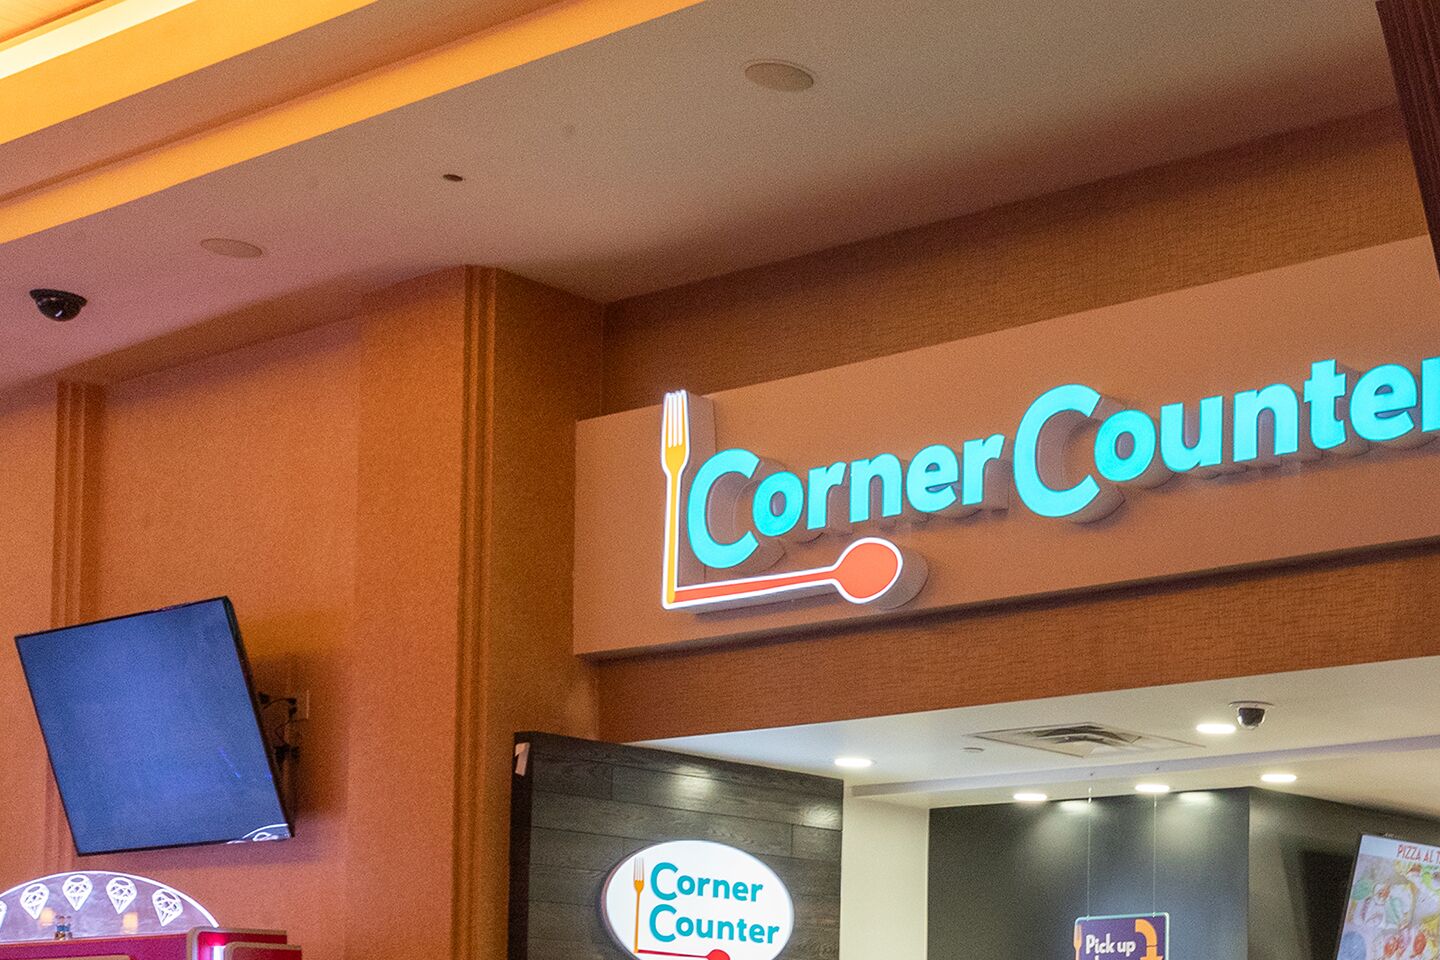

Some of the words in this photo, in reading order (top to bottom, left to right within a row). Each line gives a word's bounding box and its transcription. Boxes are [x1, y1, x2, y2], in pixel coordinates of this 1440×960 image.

[1396, 844, 1422, 861] PIZZA
[1423, 849, 1435, 863] AL
[649, 861, 764, 902] Corner
[648, 903, 780, 944] Counter
[1085, 933, 1115, 955] Pick
[1116, 940, 1137, 957] up
